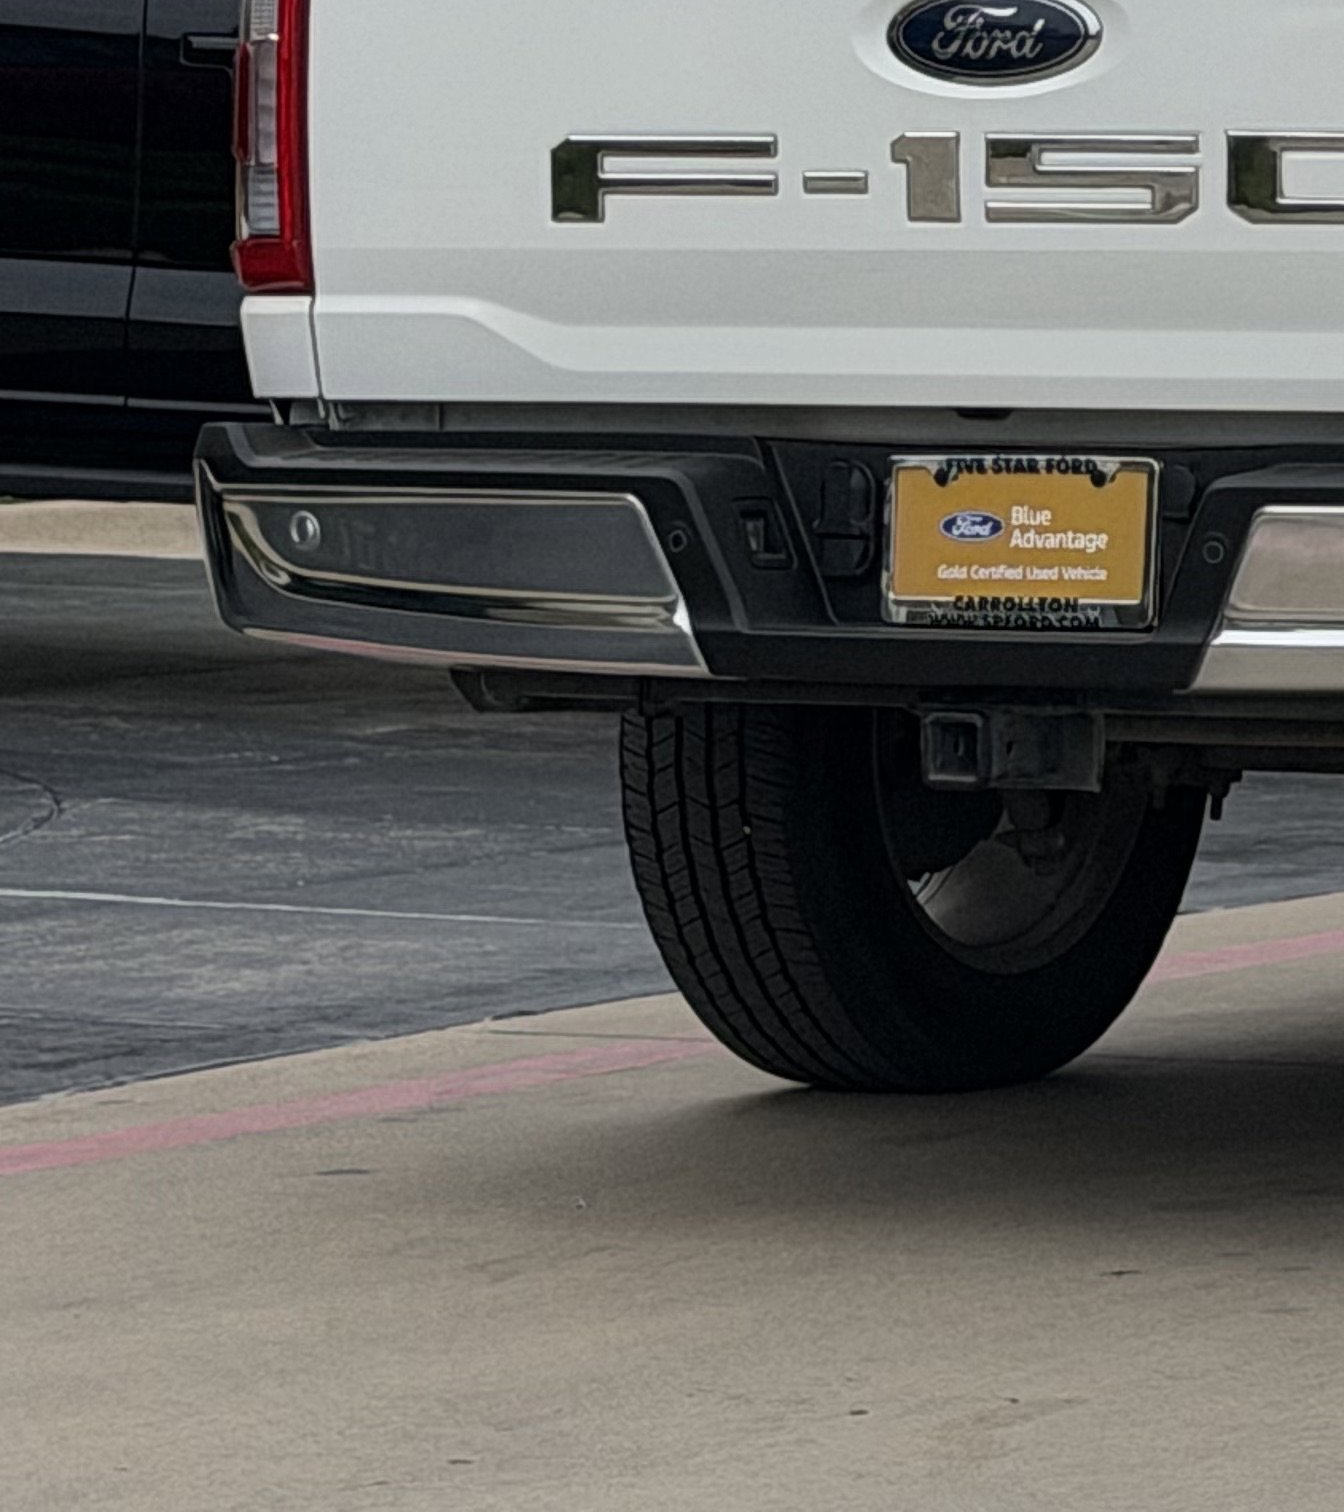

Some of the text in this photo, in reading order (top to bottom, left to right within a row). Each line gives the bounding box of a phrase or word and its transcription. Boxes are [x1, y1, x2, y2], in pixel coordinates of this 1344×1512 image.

[931, 4, 1046, 60] Ford
[991, 457, 1040, 475] STAR
[1046, 458, 1098, 475] FORD
[951, 514, 994, 536] Ford
[1010, 505, 1052, 526] Blue
[1009, 530, 1109, 553] Advantage
[937, 564, 1108, 581] Gold Certified Used Vehicle
[953, 594, 1079, 613] CARROLLTON
